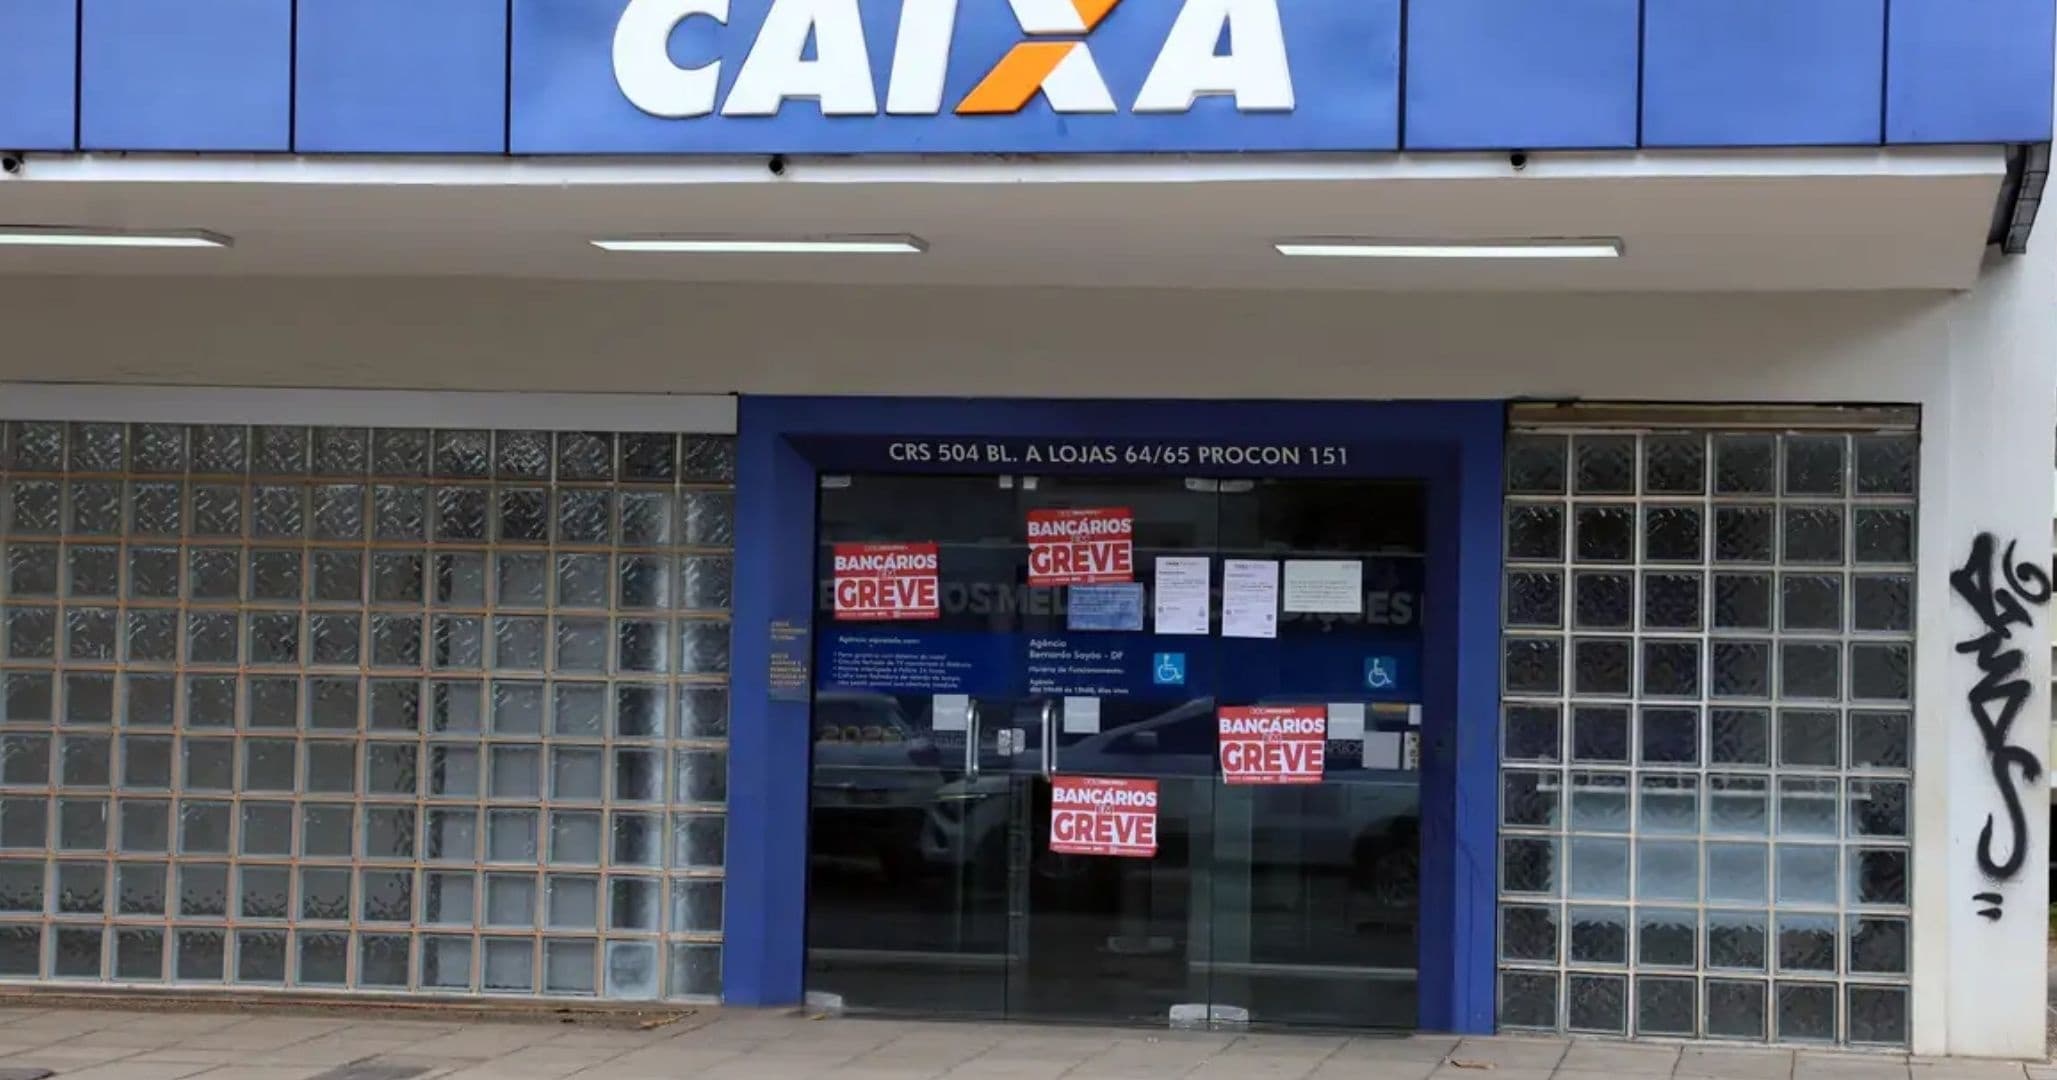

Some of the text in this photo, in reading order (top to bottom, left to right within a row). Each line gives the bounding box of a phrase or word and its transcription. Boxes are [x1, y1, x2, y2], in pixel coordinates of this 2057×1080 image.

[612, 0, 1295, 118] CAIXA
[889, 443, 1347, 465] CRS 504 BL. A LOJAS 64/65 PROCON 151
[1028, 517, 1132, 536] BANCÁRIOS
[835, 553, 937, 570] BANCÁRIOS
[1031, 543, 1130, 574] GREVE
[838, 579, 936, 608] GREVE
[1219, 716, 1325, 733] BANCÁRIOS
[1222, 743, 1322, 772] GREVE
[1052, 787, 1158, 807] BANCÁRIOS
[1054, 812, 1154, 844] GREVE
